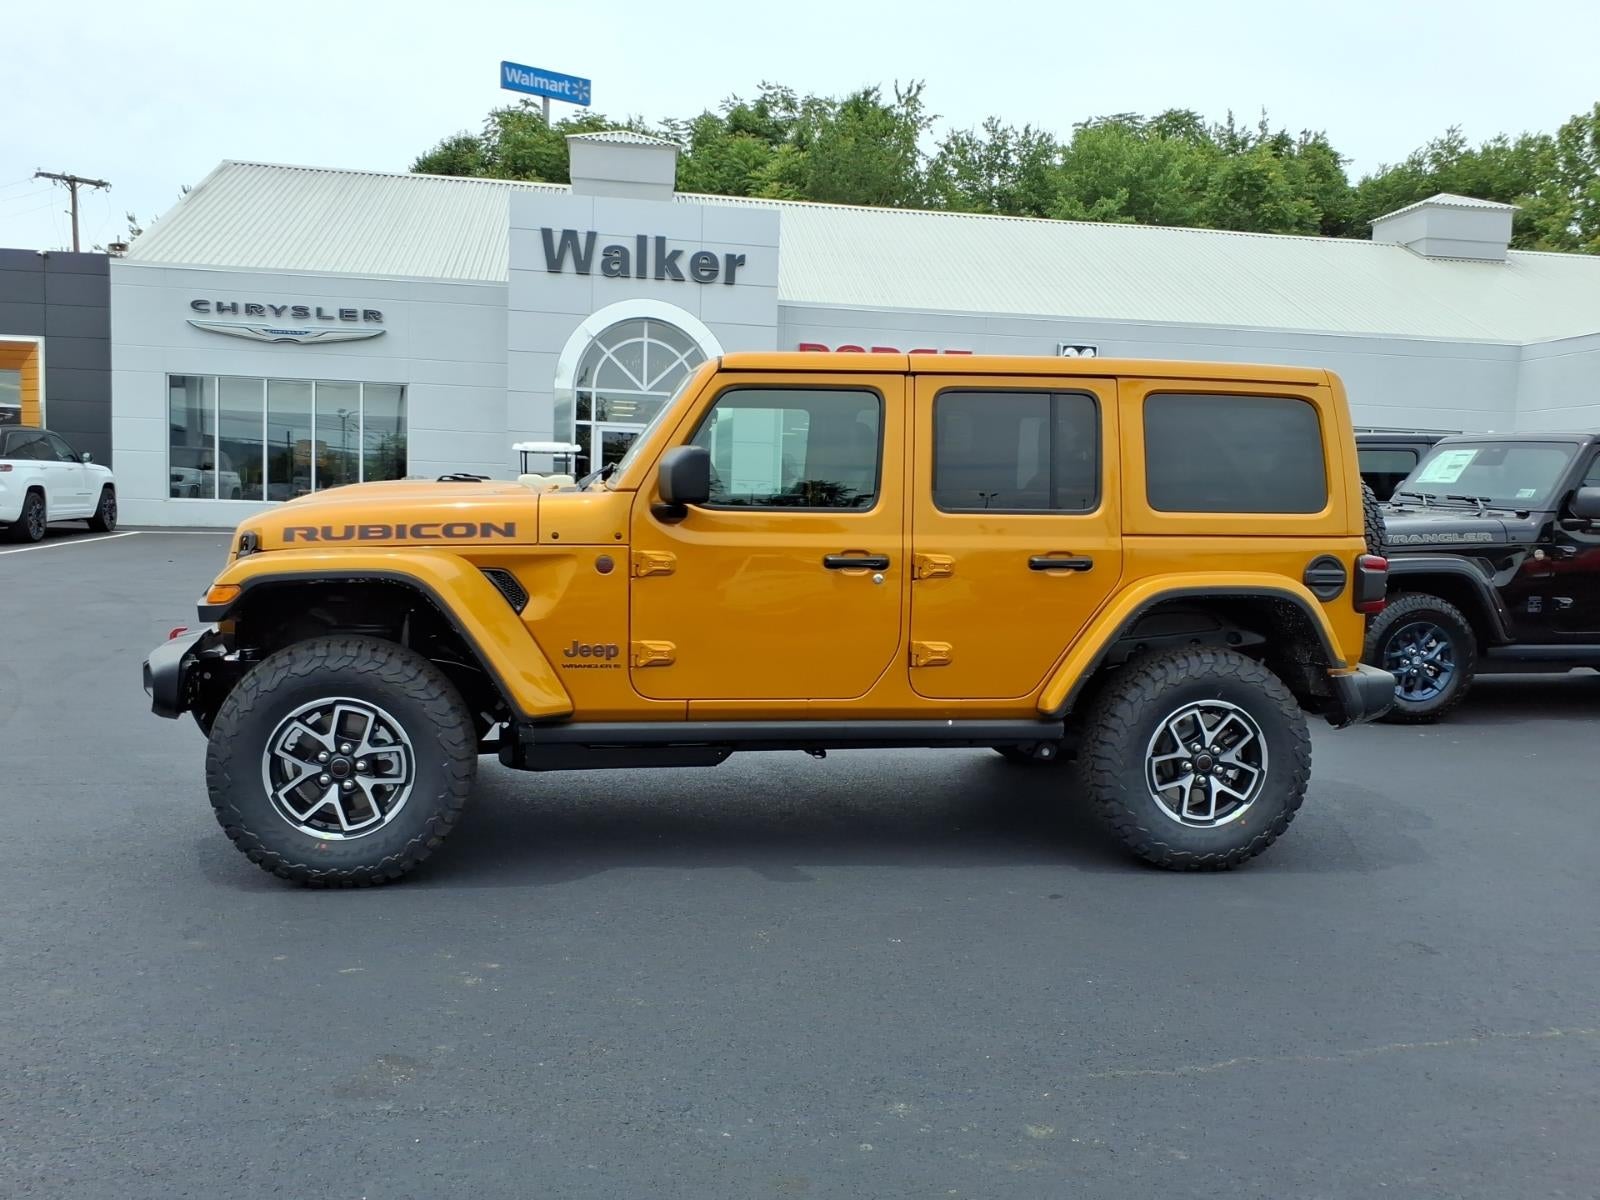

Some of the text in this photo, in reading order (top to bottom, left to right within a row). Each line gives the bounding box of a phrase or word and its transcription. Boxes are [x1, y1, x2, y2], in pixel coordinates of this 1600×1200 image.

[504, 66, 571, 95] Walmart
[540, 227, 746, 285] Walker
[190, 299, 384, 323] CHRYSLER
[282, 522, 516, 542] RUBICON
[563, 639, 619, 660] Jeep
